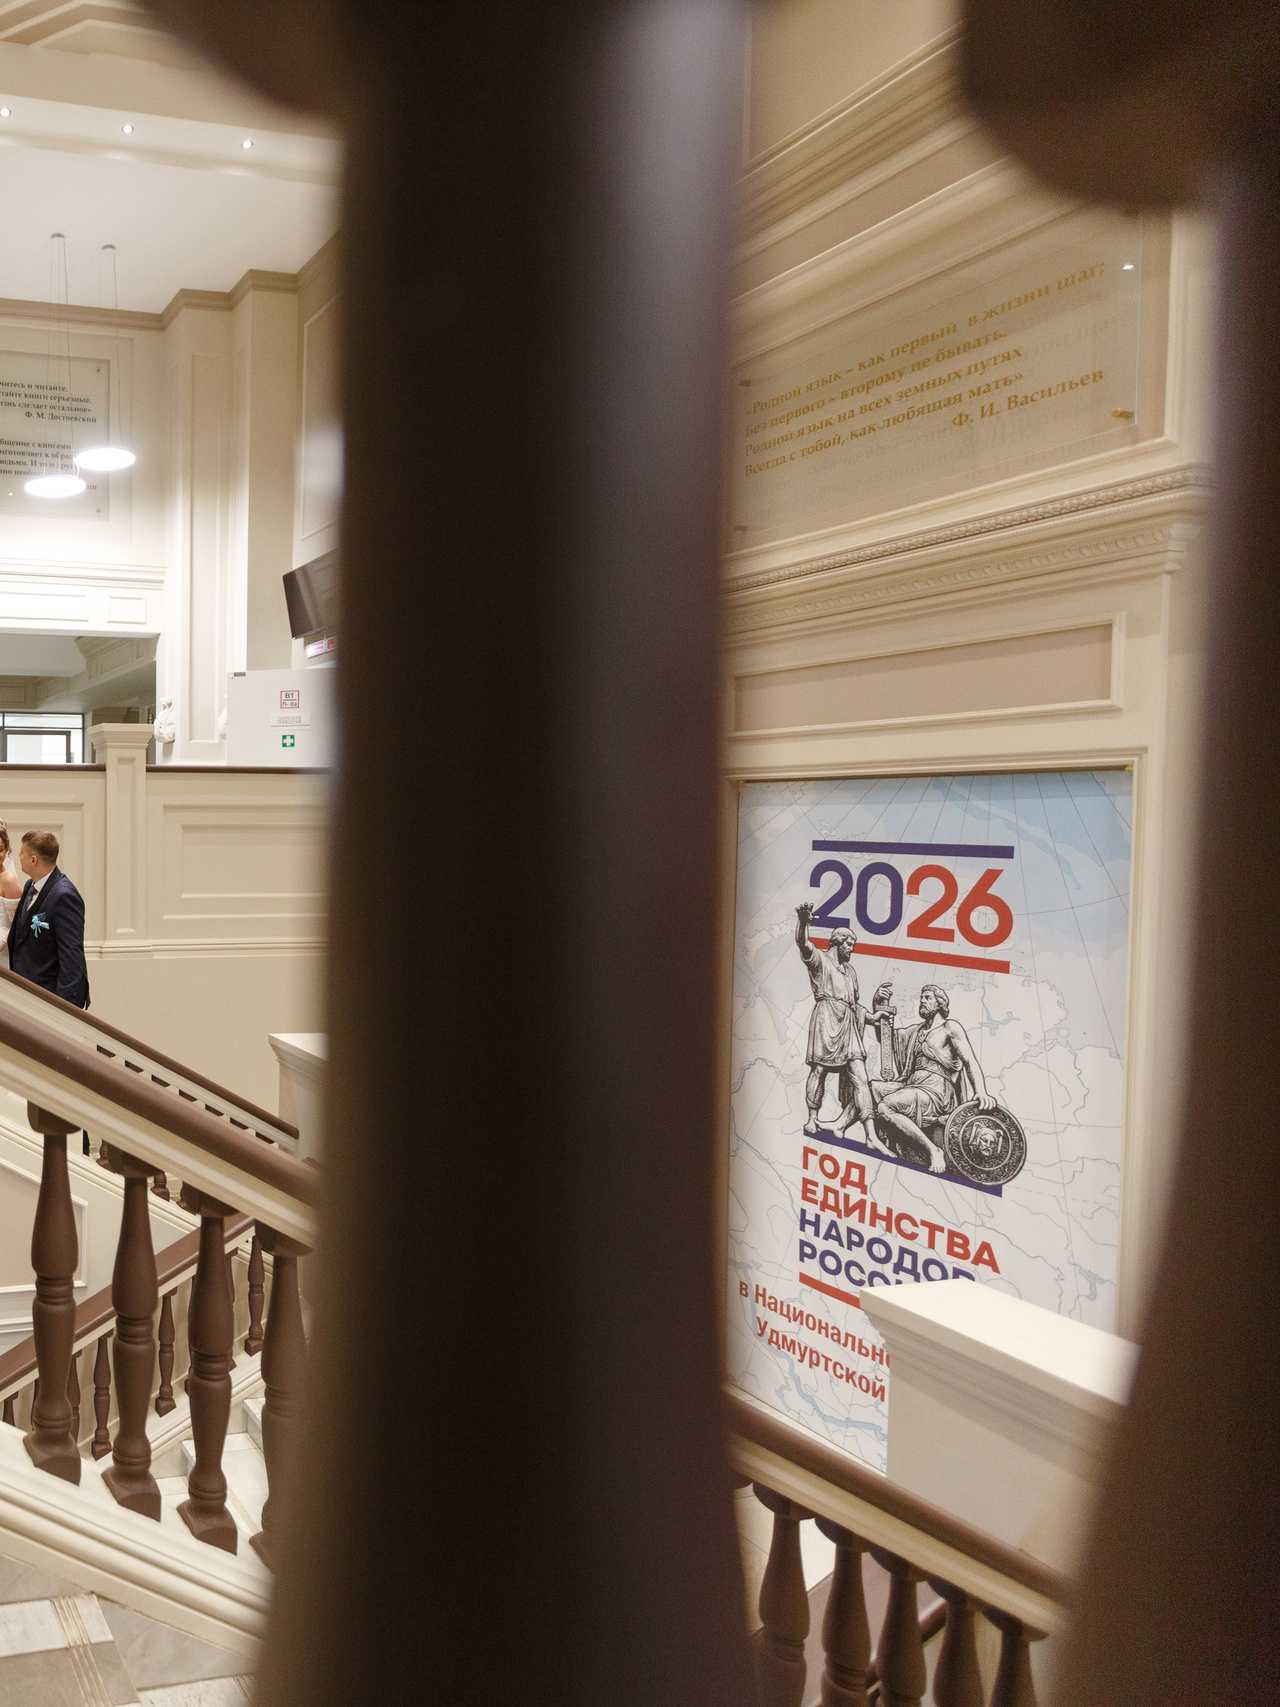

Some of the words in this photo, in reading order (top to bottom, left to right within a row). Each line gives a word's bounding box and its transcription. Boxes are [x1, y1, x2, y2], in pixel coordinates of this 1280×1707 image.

[746, 386, 802, 416] «Родной
[805, 371, 842, 394] язык
[858, 354, 885, 372] как
[890, 321, 957, 359] первый
[967, 314, 978, 327] в
[983, 284, 1050, 321] жизни
[746, 421, 767, 437] Без
[770, 399, 825, 428] первого
[840, 366, 906, 401] второму
[910, 357, 931, 374] не
[935, 329, 1008, 363] бывать.
[18, 402, 47, 410] сделает
[49, 404, 91, 413] остальное»
[24, 411, 35, 419] Ф.
[36, 412, 46, 420] М.
[47, 413, 97, 424] Достоевский
[34, 384, 68, 393] читайте.
[745, 430, 793, 456] Родной
[796, 416, 833, 439] язык
[837, 410, 855, 424] на
[859, 396, 892, 416] всех
[896, 367, 962, 402] земных
[966, 346, 1022, 377] путях
[951, 411, 973, 427] Ф.
[979, 402, 1000, 420] И.
[1006, 369, 1104, 412] Васильев
[37, 443, 72, 451] книгами
[744, 454, 786, 478] Всегда
[789, 450, 796, 461] с
[800, 433, 845, 457] тобой,
[849, 421, 877, 441] как
[879, 392, 963, 430] любящая
[968, 372, 1023, 400] мать»
[809, 859, 1014, 948] 2026
[802, 1145, 868, 1196] ГОД
[800, 1176, 1001, 1275] ЕДИНСТВА
[739, 1280, 749, 1299] в
[756, 1316, 886, 1403] Удмуртской
